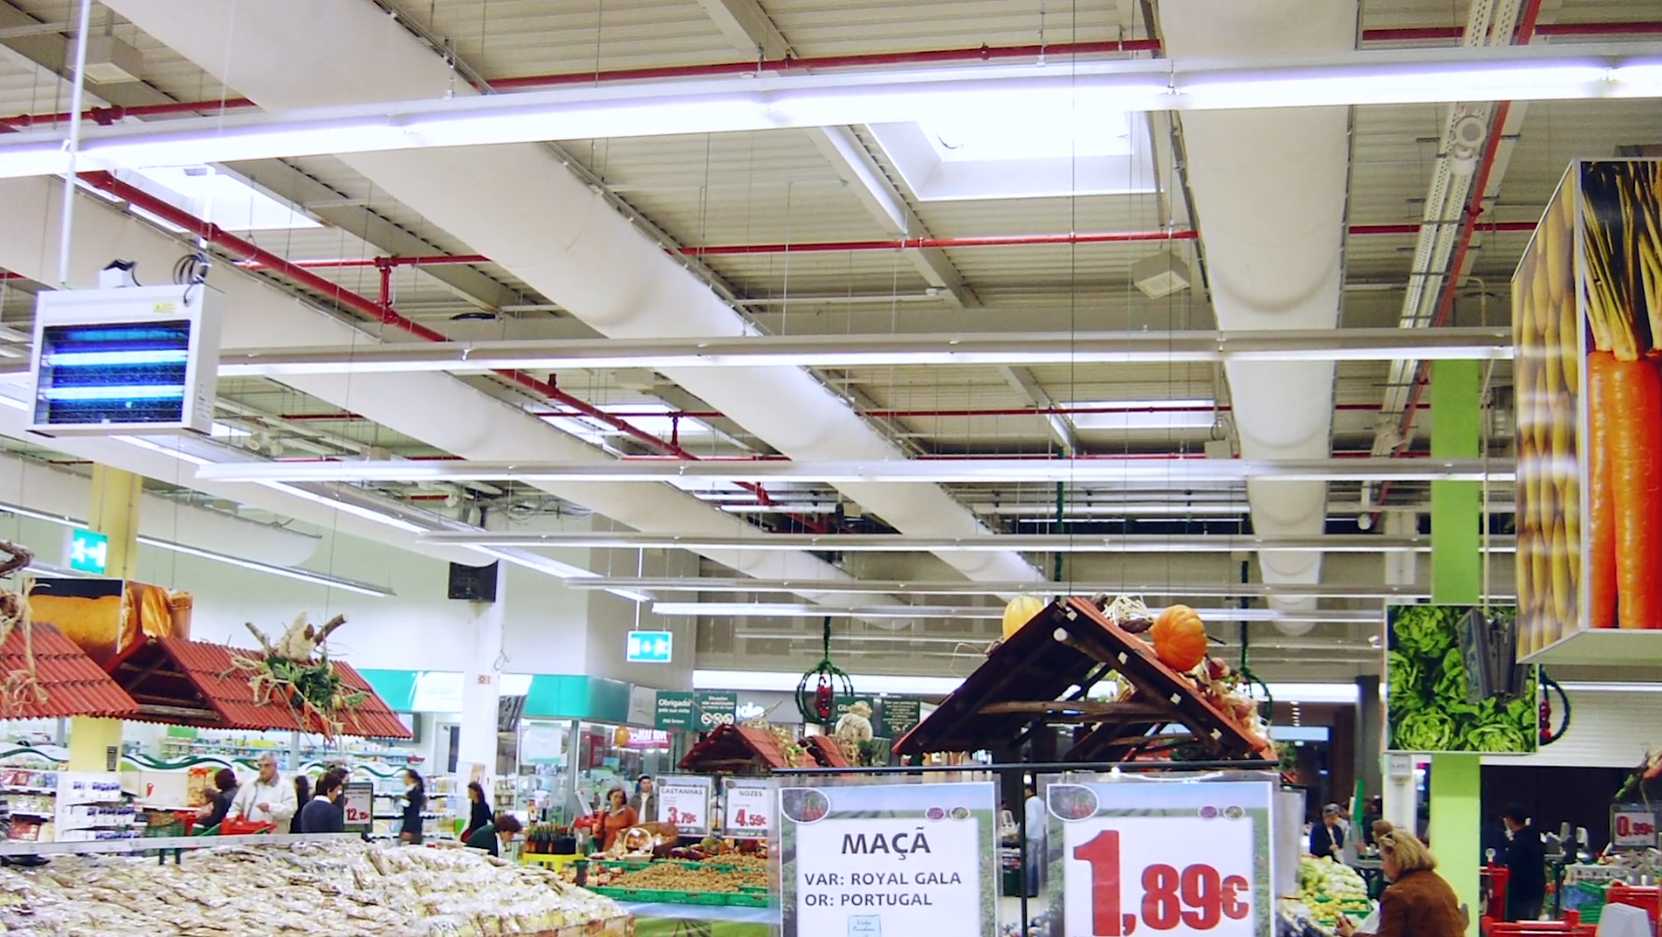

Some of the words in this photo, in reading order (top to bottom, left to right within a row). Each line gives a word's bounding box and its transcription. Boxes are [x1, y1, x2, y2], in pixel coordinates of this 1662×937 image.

[660, 787, 703, 796] CASTANHAS
[841, 826, 931, 861] MAÇÃ
[804, 873, 845, 886] VAR:
[851, 872, 909, 886] ROYAL
[914, 872, 962, 885] GALA
[1072, 829, 1249, 937] 1,89€
[804, 894, 835, 907] OR:
[840, 893, 933, 907] PORTUGAL
